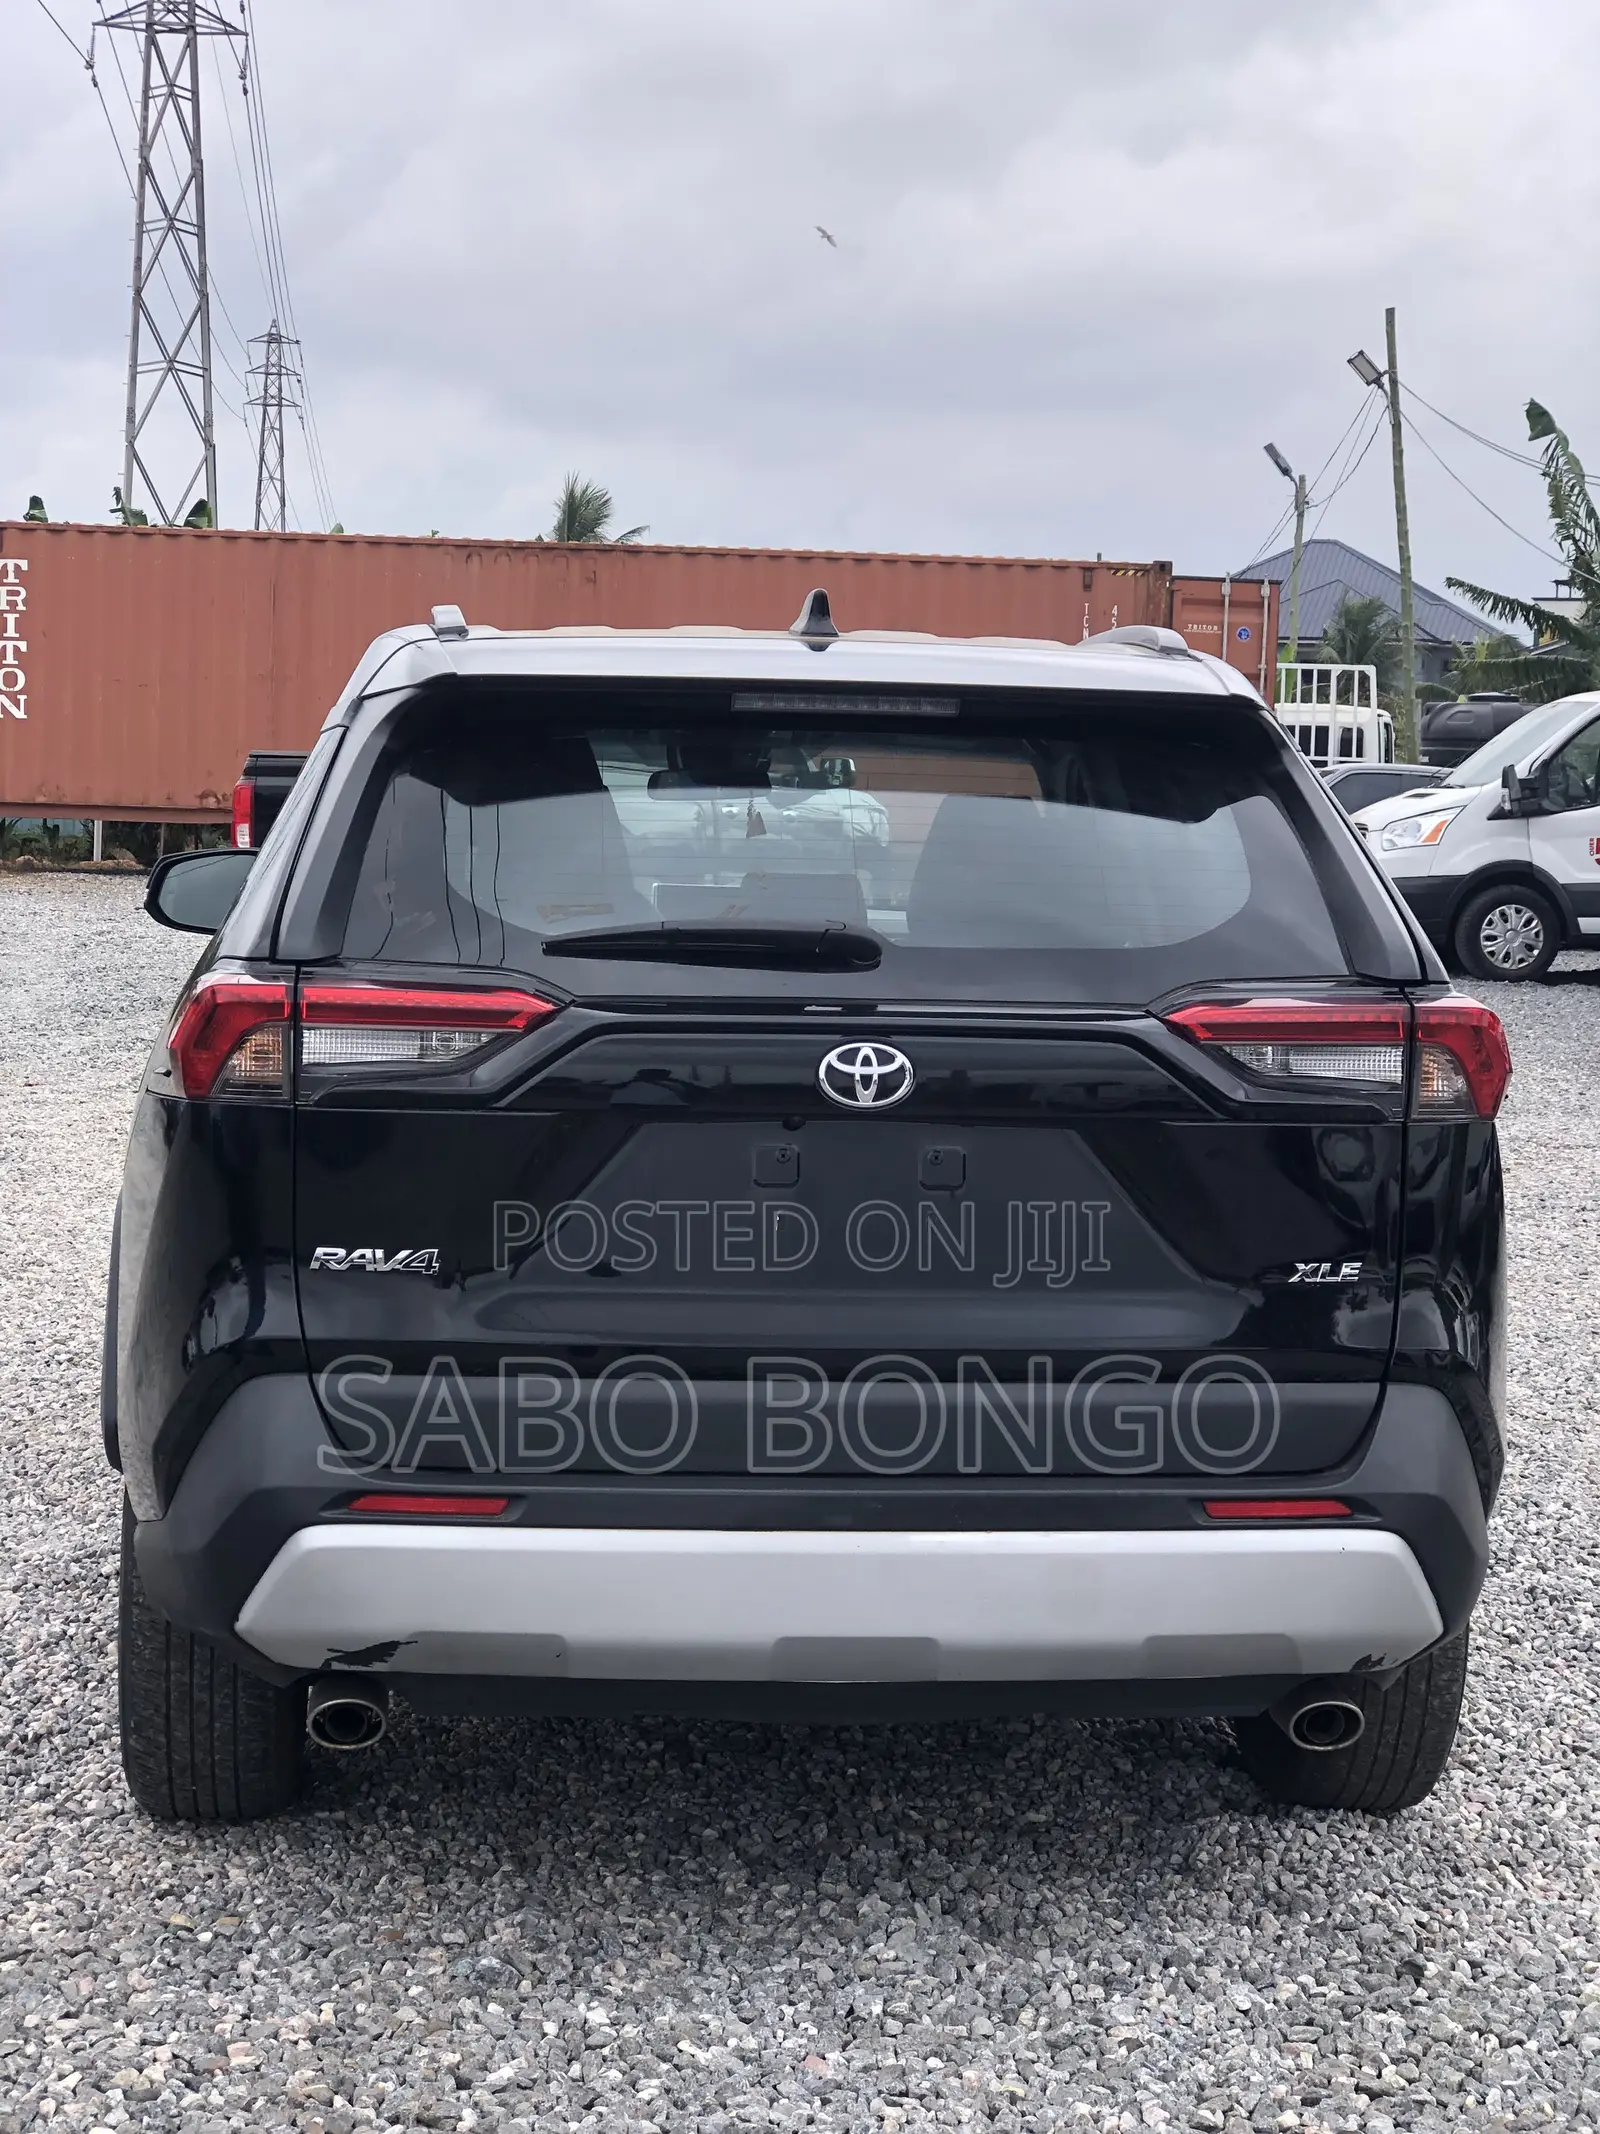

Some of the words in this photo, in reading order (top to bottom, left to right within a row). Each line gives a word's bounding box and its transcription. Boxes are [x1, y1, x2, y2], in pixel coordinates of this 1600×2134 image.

[0, 558, 28, 719] TRITON
[1187, 623, 1219, 631] TRITON
[309, 1246, 441, 1275] RAV4
[1287, 1262, 1363, 1283] XLE
